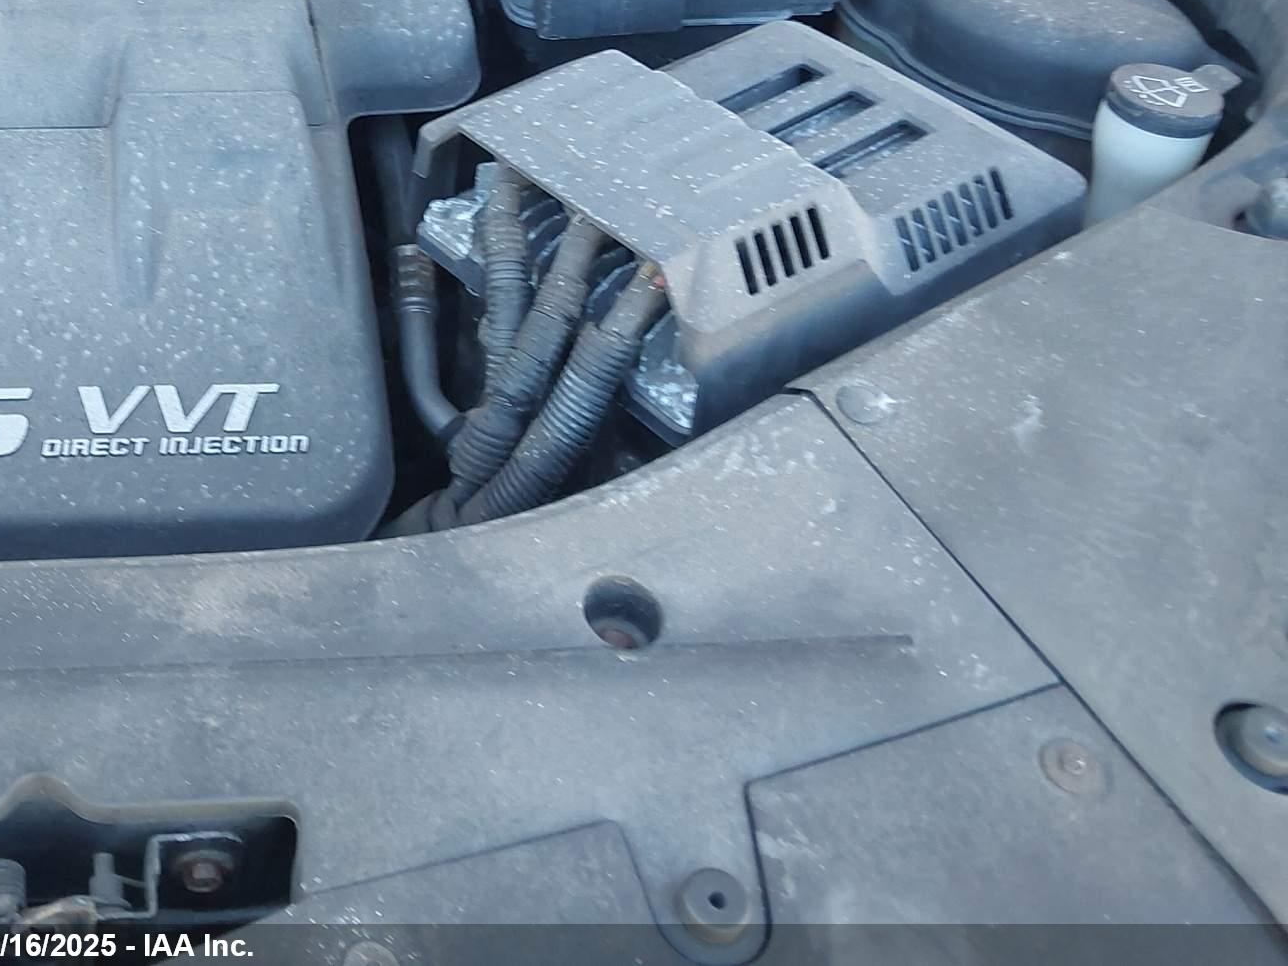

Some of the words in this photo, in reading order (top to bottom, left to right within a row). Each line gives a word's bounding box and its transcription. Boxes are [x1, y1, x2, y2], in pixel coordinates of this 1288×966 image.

[78, 383, 281, 434] VVT
[40, 436, 150, 458] DIRECT
[159, 434, 310, 456] INJECTION
